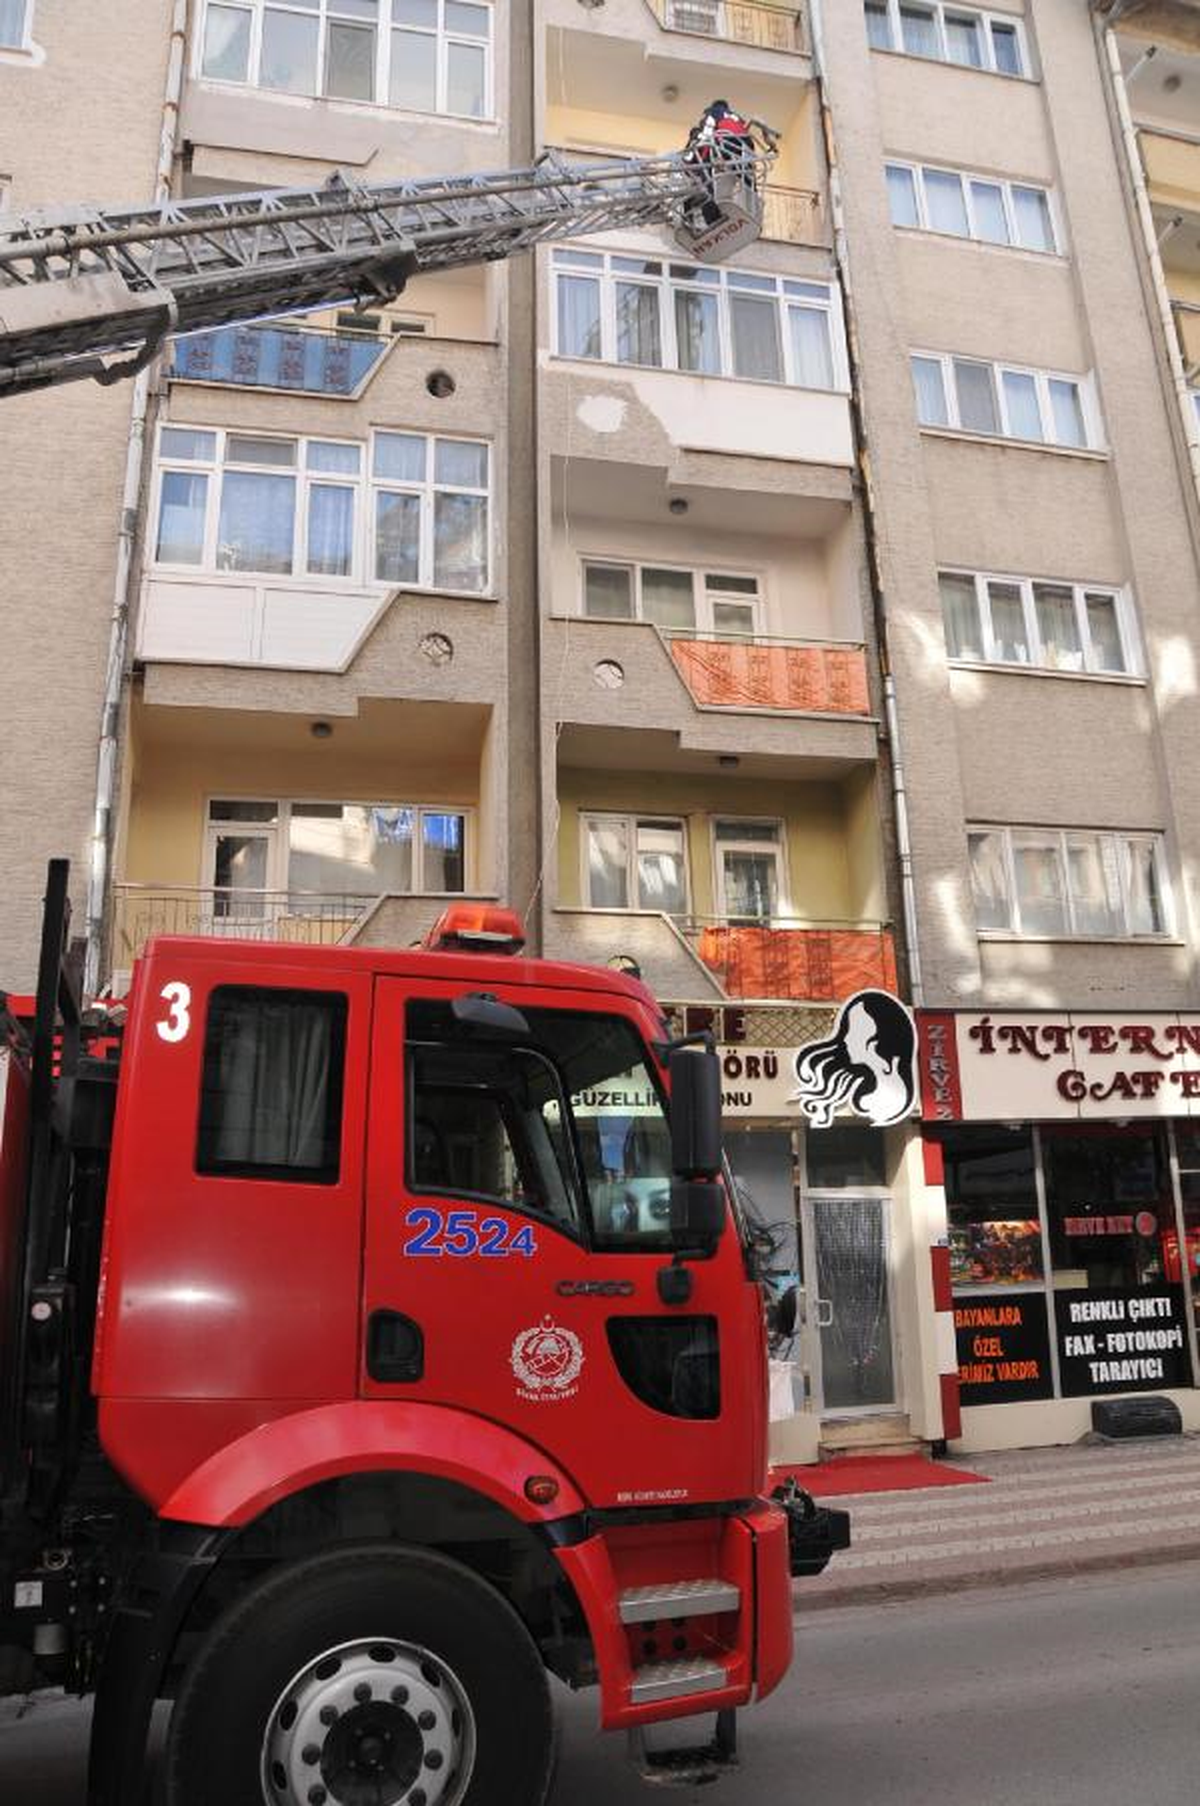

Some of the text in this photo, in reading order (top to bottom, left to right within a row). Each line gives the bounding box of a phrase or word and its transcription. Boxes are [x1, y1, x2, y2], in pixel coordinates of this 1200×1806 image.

[156, 981, 191, 1043] 3
[723, 1049, 778, 1079] ÖRÜ
[404, 1207, 538, 1257] 2524
[973, 1335, 1004, 1357] ÖZEL
[1065, 1334, 1096, 1356] FAX
[1106, 1325, 1182, 1353] FOTOKOPİ
